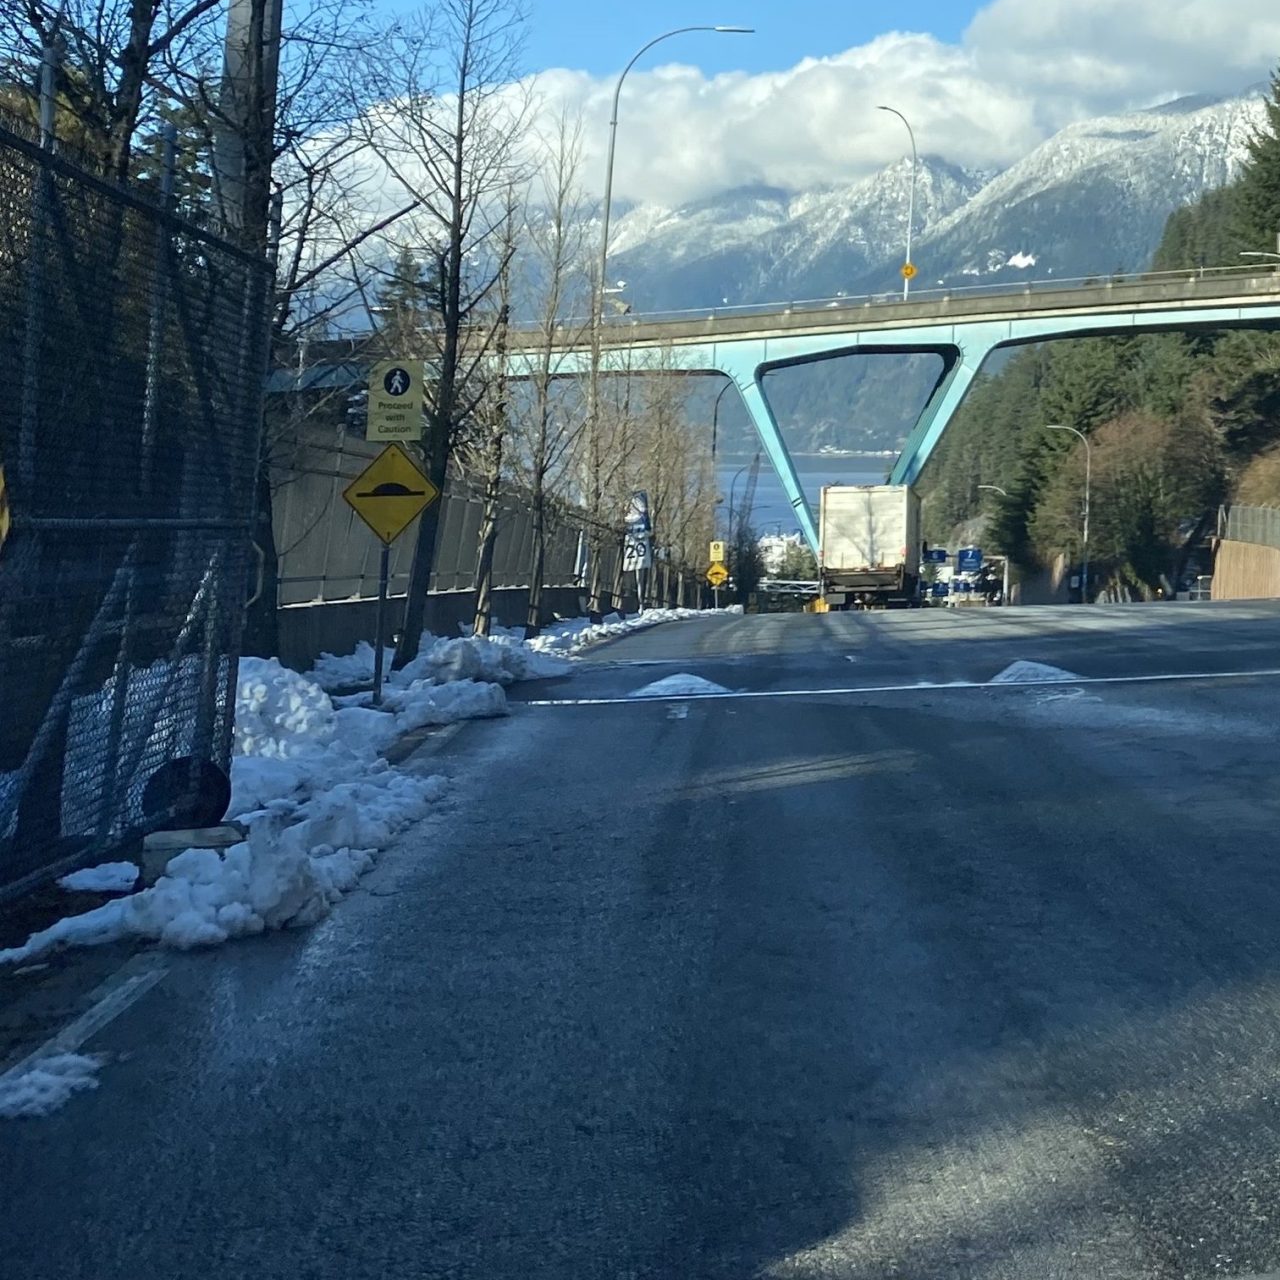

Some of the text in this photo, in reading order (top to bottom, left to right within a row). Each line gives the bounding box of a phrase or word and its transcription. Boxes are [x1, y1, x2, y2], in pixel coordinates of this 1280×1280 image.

[378, 401, 413, 410] Proceed
[385, 414, 405, 422] with
[378, 425, 412, 434] Caution
[626, 542, 646, 559] 20
